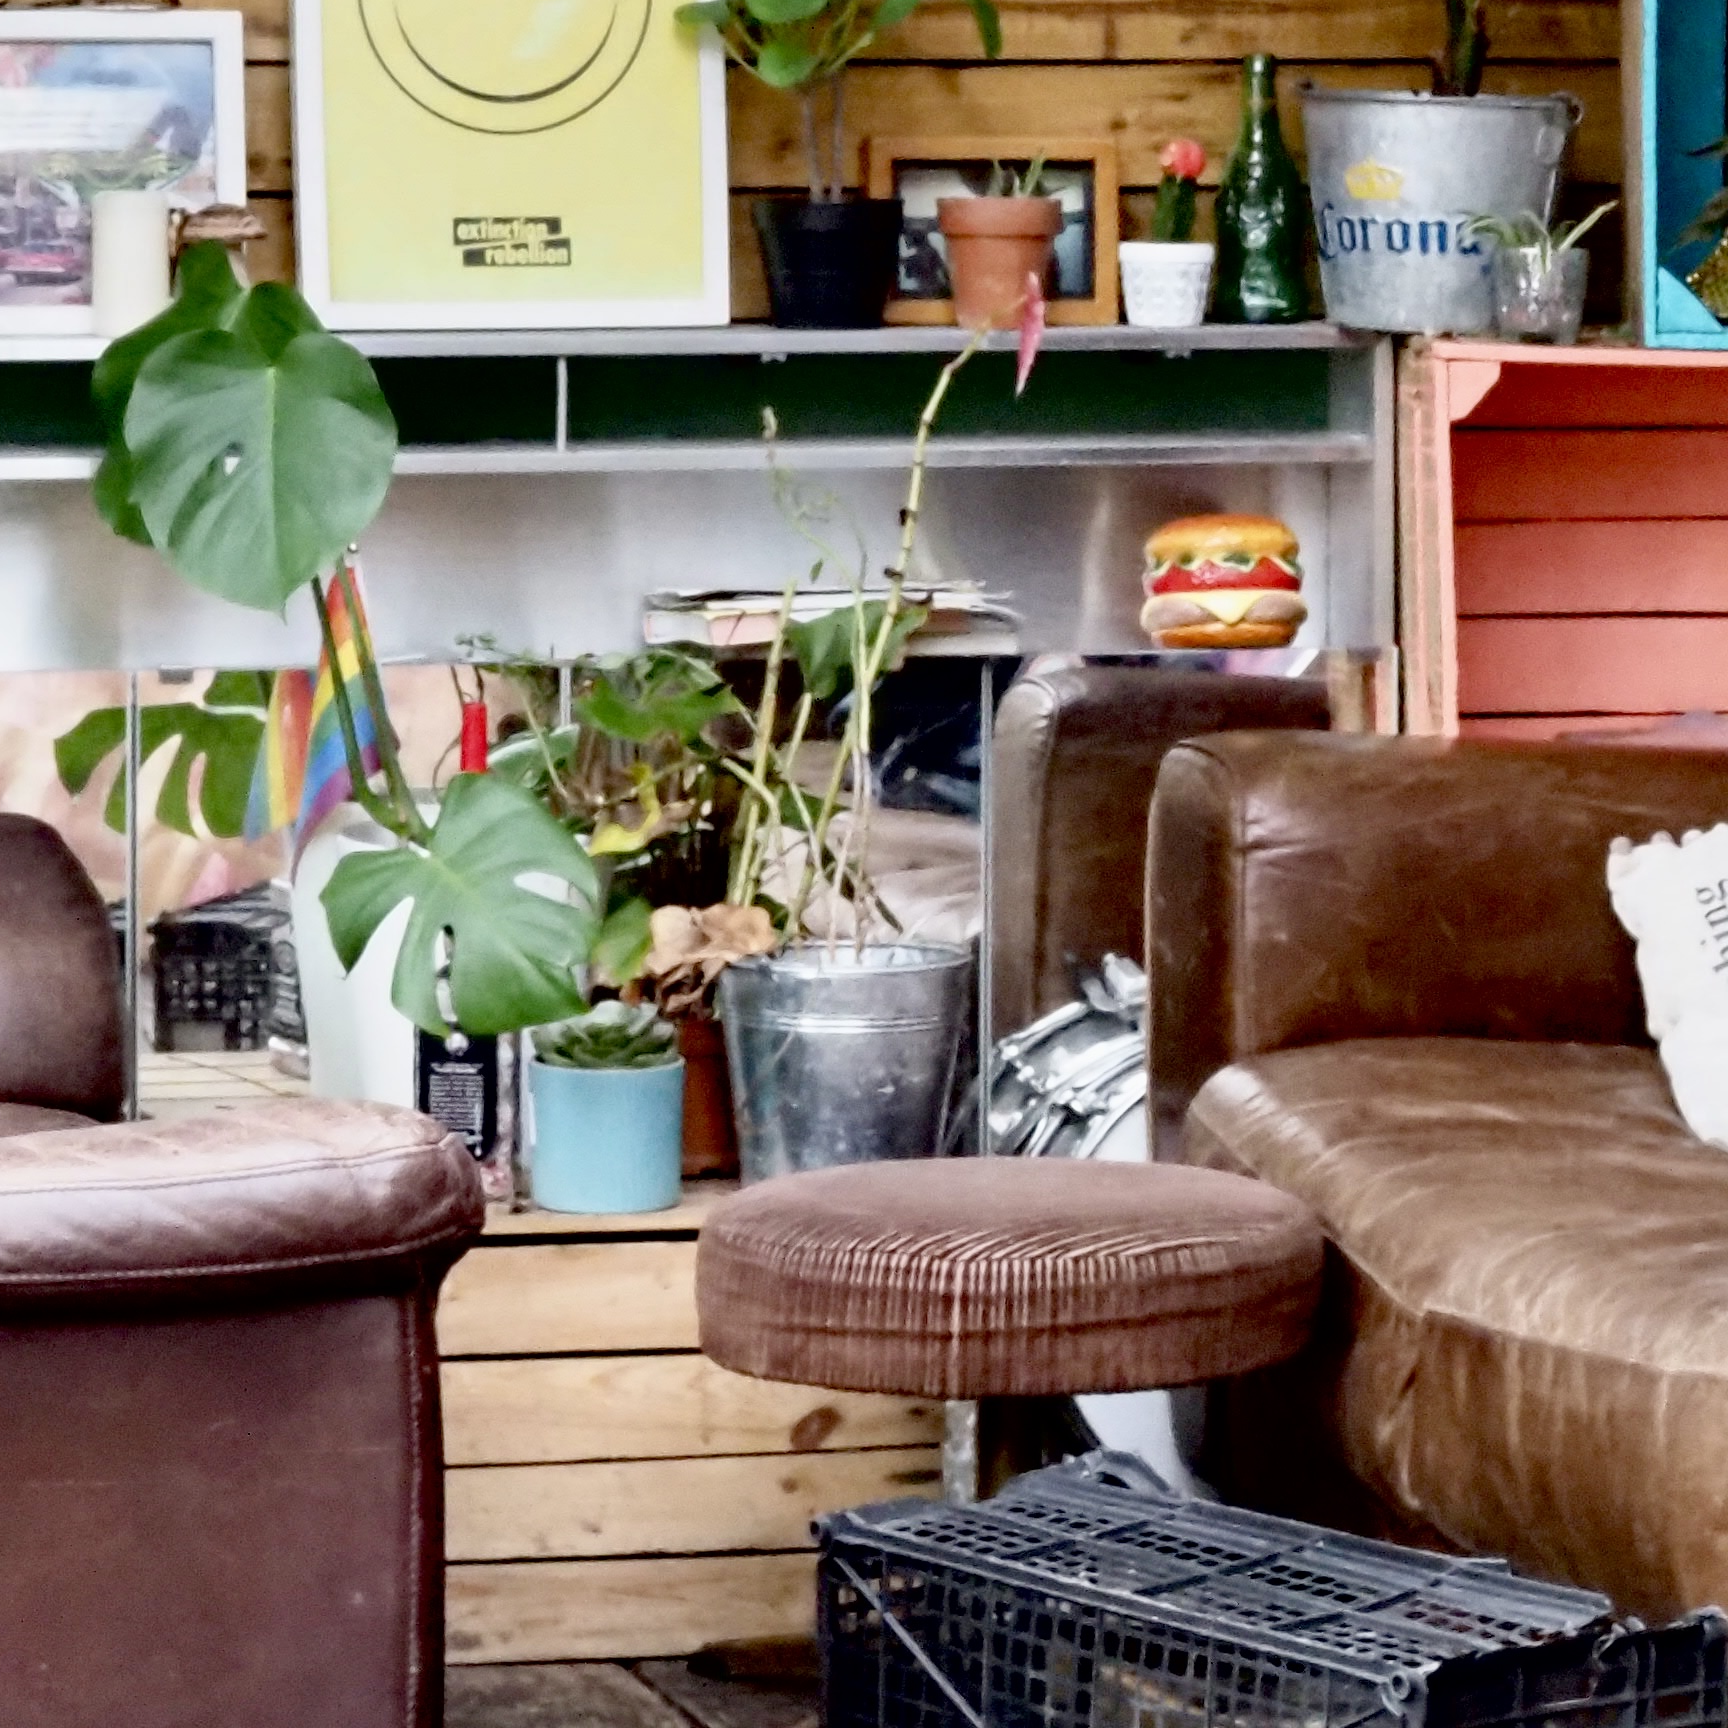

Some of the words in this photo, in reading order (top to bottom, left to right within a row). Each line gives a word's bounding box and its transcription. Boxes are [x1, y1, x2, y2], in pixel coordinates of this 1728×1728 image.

[456, 217, 548, 241] extinction
[1319, 201, 1482, 260] Corona
[485, 238, 569, 265] rebellion
